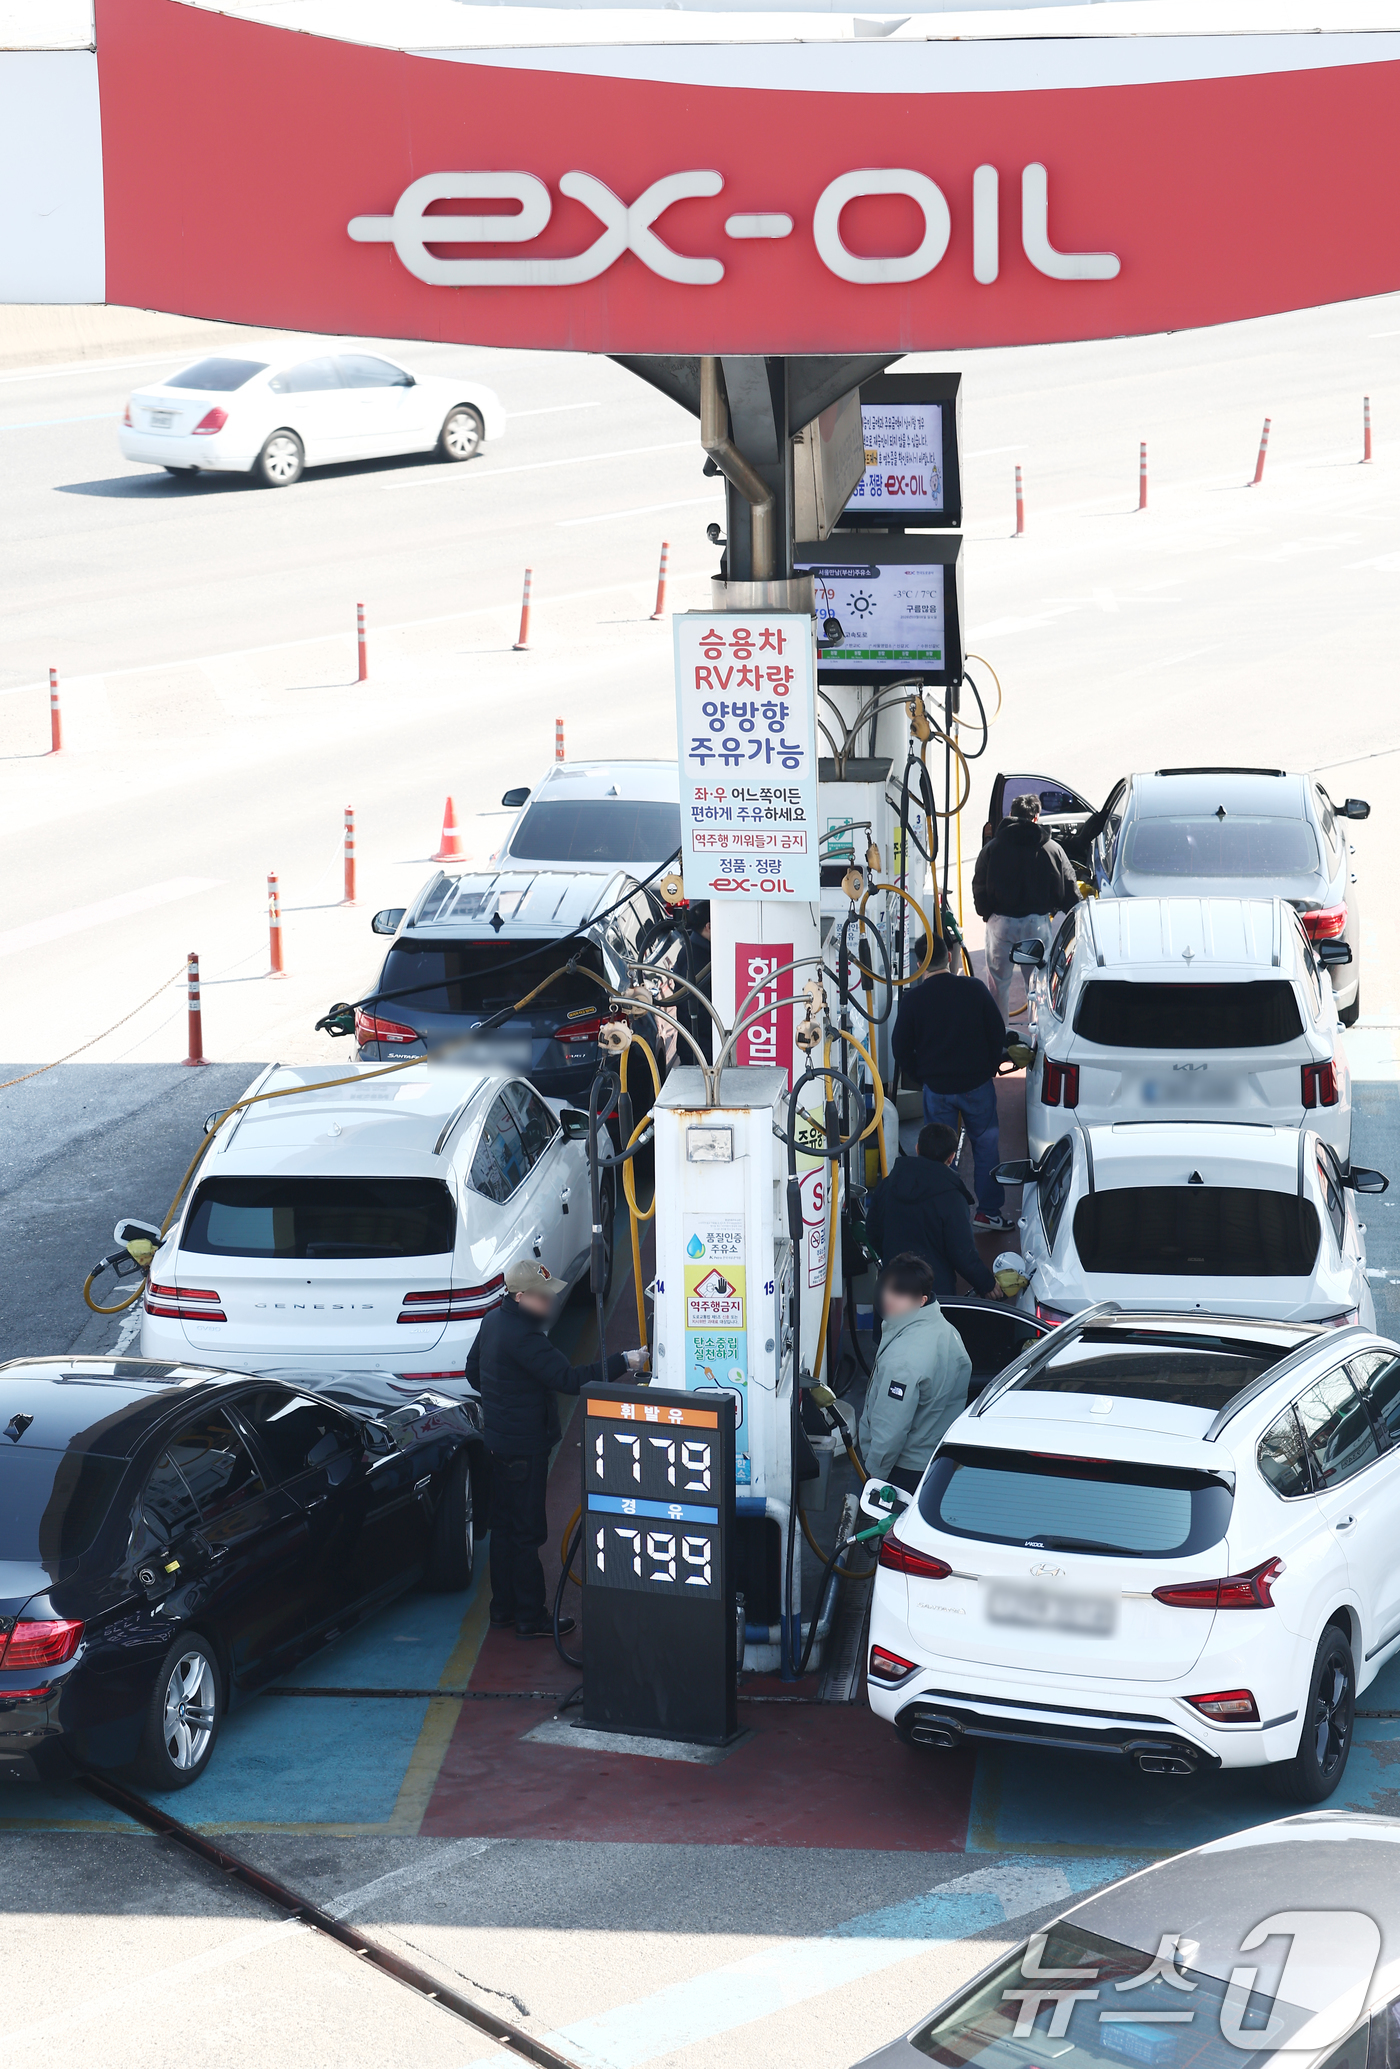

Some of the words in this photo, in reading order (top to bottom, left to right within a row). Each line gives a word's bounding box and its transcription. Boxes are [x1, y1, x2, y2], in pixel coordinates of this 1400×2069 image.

[699, 628, 787, 660] 승용차
[694, 664, 795, 697] RV차량
[702, 700, 790, 733] 양방향
[688, 737, 805, 770] 주유가능
[694, 787, 728, 803] 좌·우
[731, 788, 802, 805] 어느쪽이든
[691, 806, 733, 822] 편하게
[736, 807, 806, 822] 주유하세요
[695, 833, 729, 848] 역주행
[732, 834, 777, 848] 끼워들기
[780, 835, 803, 848] 금지
[747, 957, 778, 1067] 화기엄
[706, 1232, 742, 1243] 품질인증
[711, 1244, 738, 1254] 주유소
[656, 1279, 665, 1294] 14
[764, 1280, 774, 1295] 15
[254, 1302, 374, 1310] GENESIS
[690, 1301, 740, 1312] 역주행금지
[693, 1337, 738, 1349] 탄소중립
[694, 1349, 738, 1361] 실천하기
[620, 1403, 684, 1425] 휘발유
[595, 1433, 711, 1492] 1779
[596, 1527, 711, 1586] 1799
